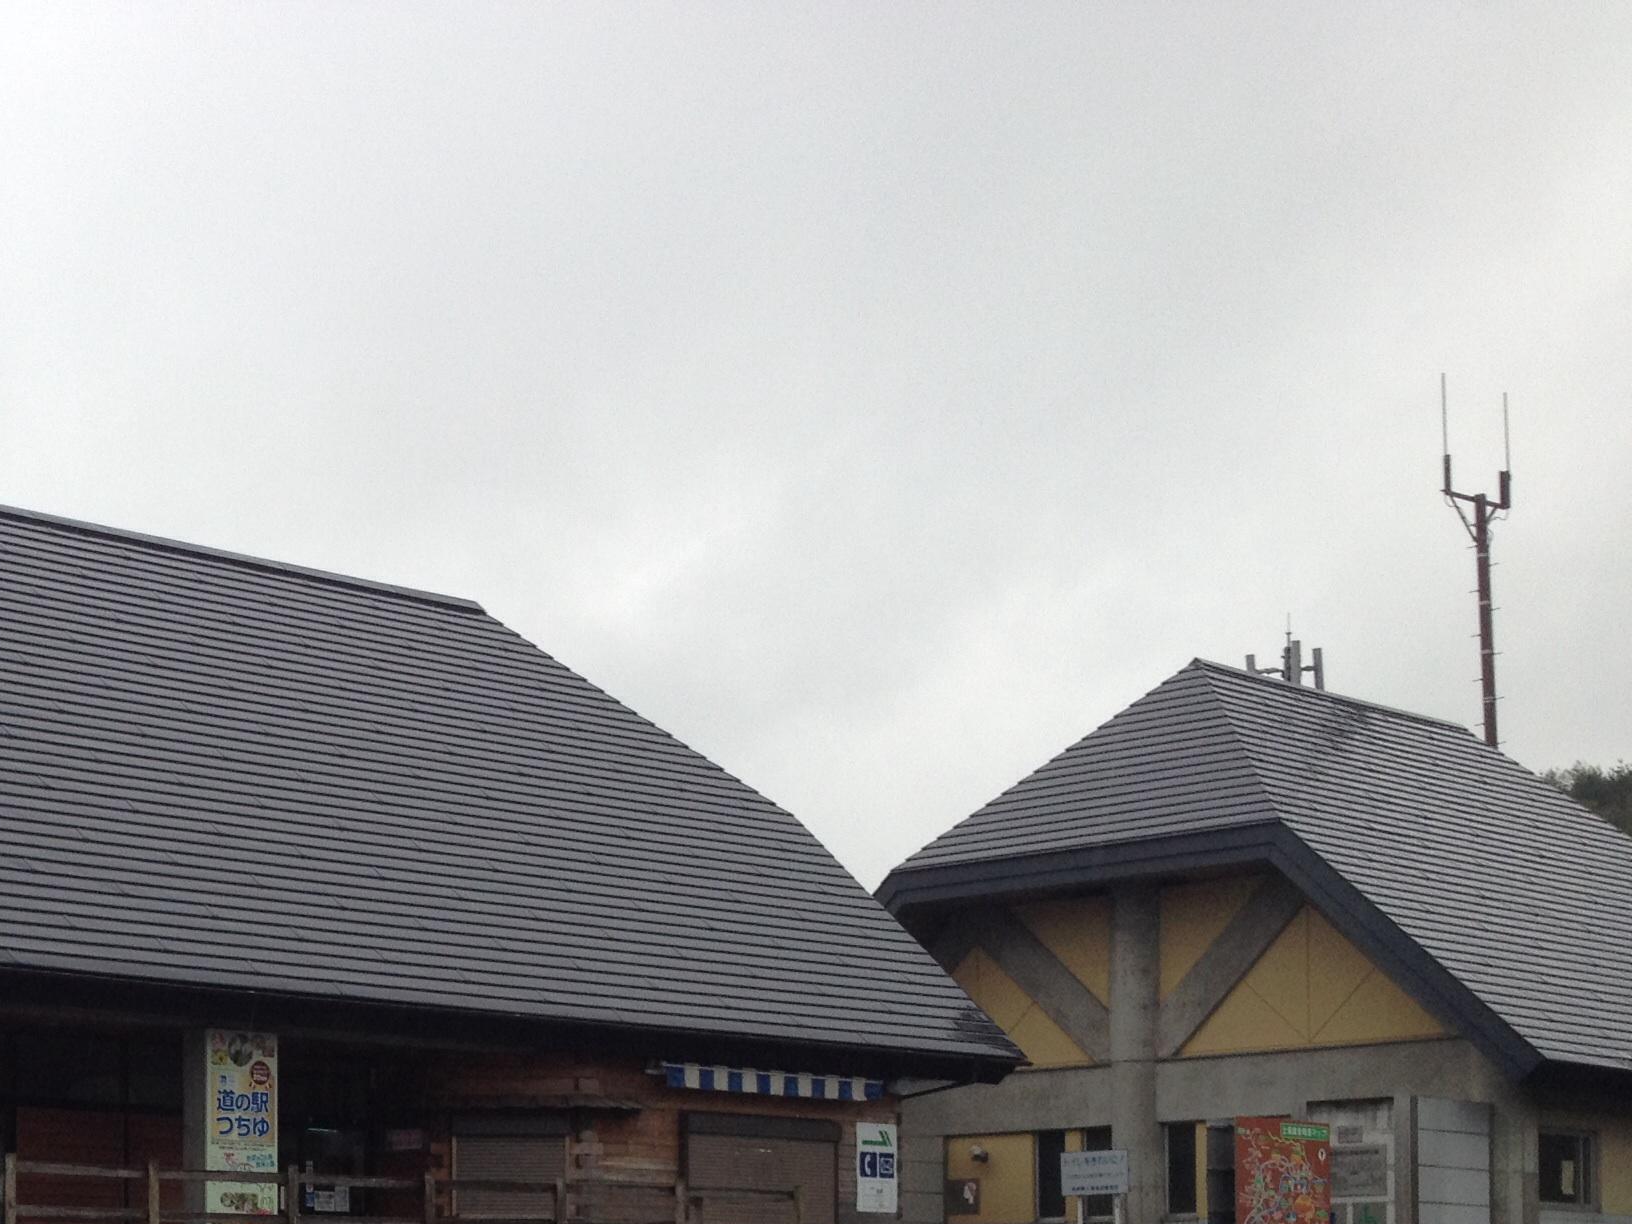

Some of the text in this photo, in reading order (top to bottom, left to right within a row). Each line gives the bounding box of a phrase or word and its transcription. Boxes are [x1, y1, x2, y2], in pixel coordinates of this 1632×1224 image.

[217, 1090, 269, 1113] 道の駅
[216, 1116, 270, 1137] つちゆ
